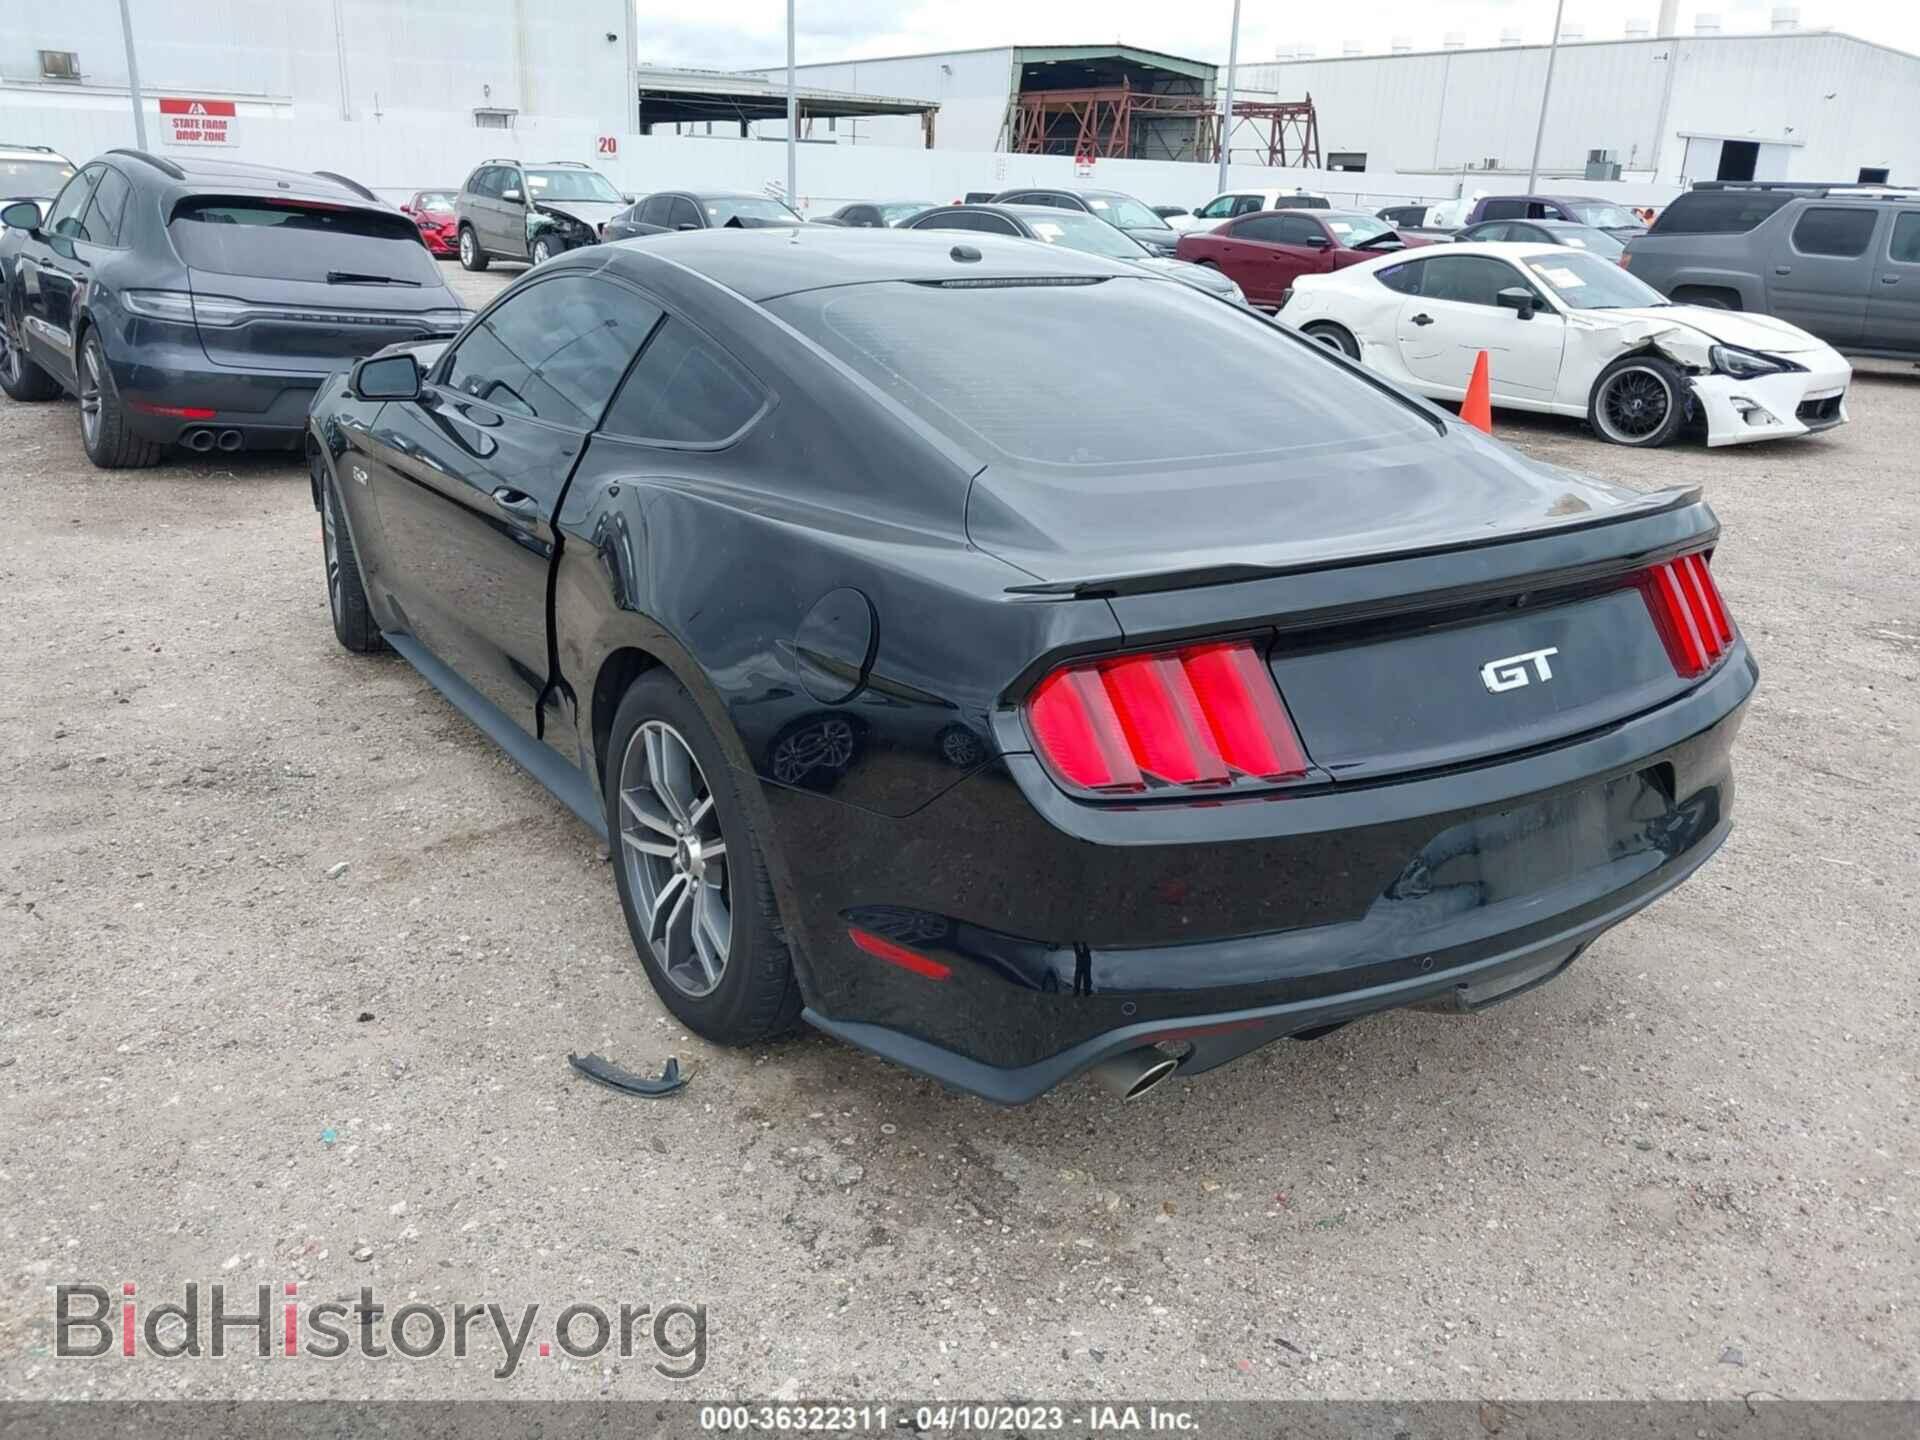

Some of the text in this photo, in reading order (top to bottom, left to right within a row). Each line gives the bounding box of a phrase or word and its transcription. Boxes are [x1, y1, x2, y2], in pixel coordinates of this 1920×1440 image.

[172, 118, 227, 130] STATE FARM
[176, 130, 226, 142] DROP ZONE
[599, 136, 617, 153] 20
[1480, 646, 1559, 693] GT
